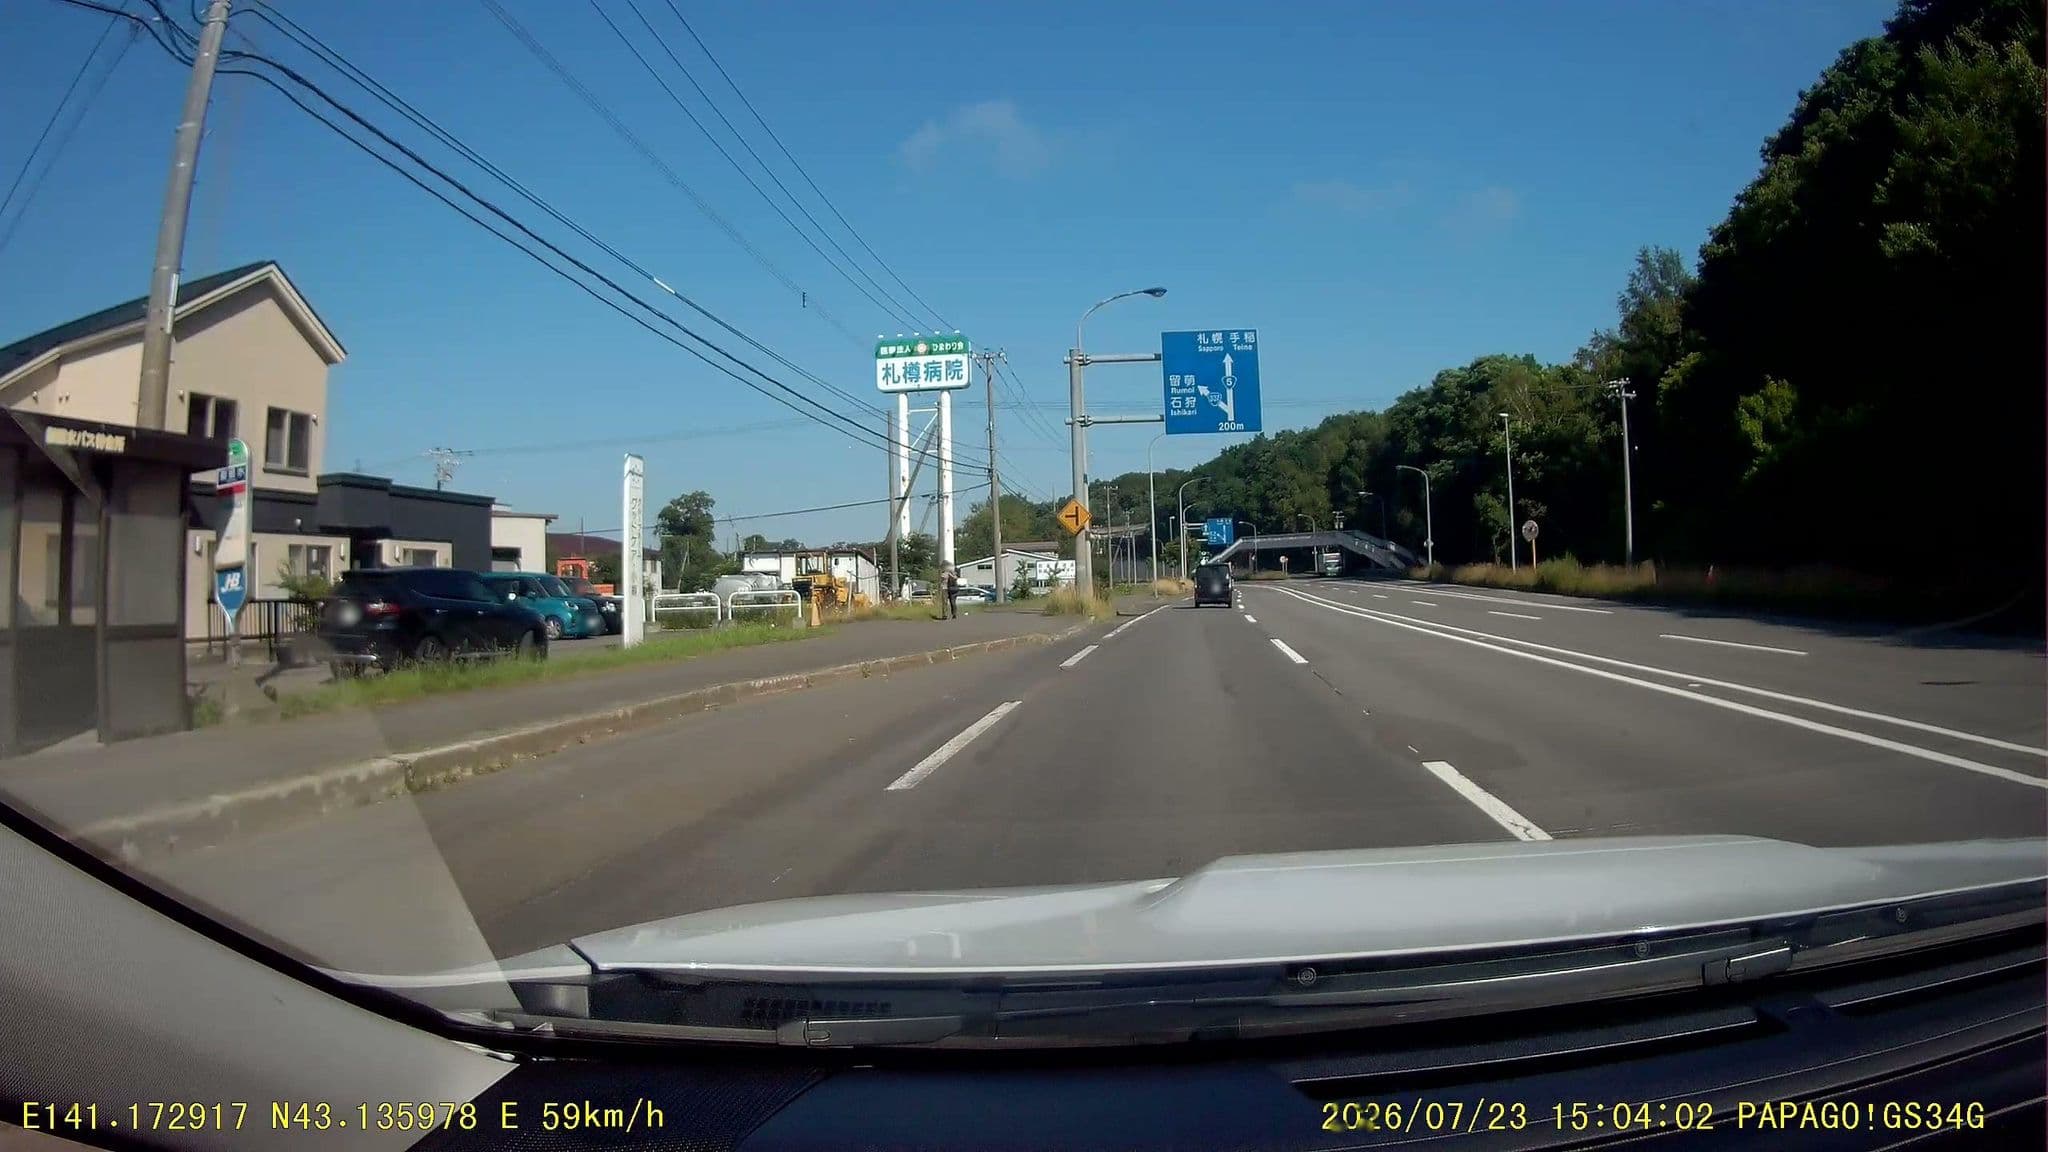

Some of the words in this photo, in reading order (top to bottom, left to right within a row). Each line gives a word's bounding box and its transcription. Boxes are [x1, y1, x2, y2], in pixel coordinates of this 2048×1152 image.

[1197, 332, 1223, 345] 札幌
[1230, 331, 1256, 344] 手稲
[932, 341, 964, 351] ひまわり会
[882, 360, 963, 385] 札樽病院
[1169, 374, 1195, 386] 留萌
[1226, 378, 1232, 386] 5
[1170, 386, 1195, 394] Rumoi
[1170, 396, 1197, 408] 石狩
[1218, 422, 1244, 431] 200m
